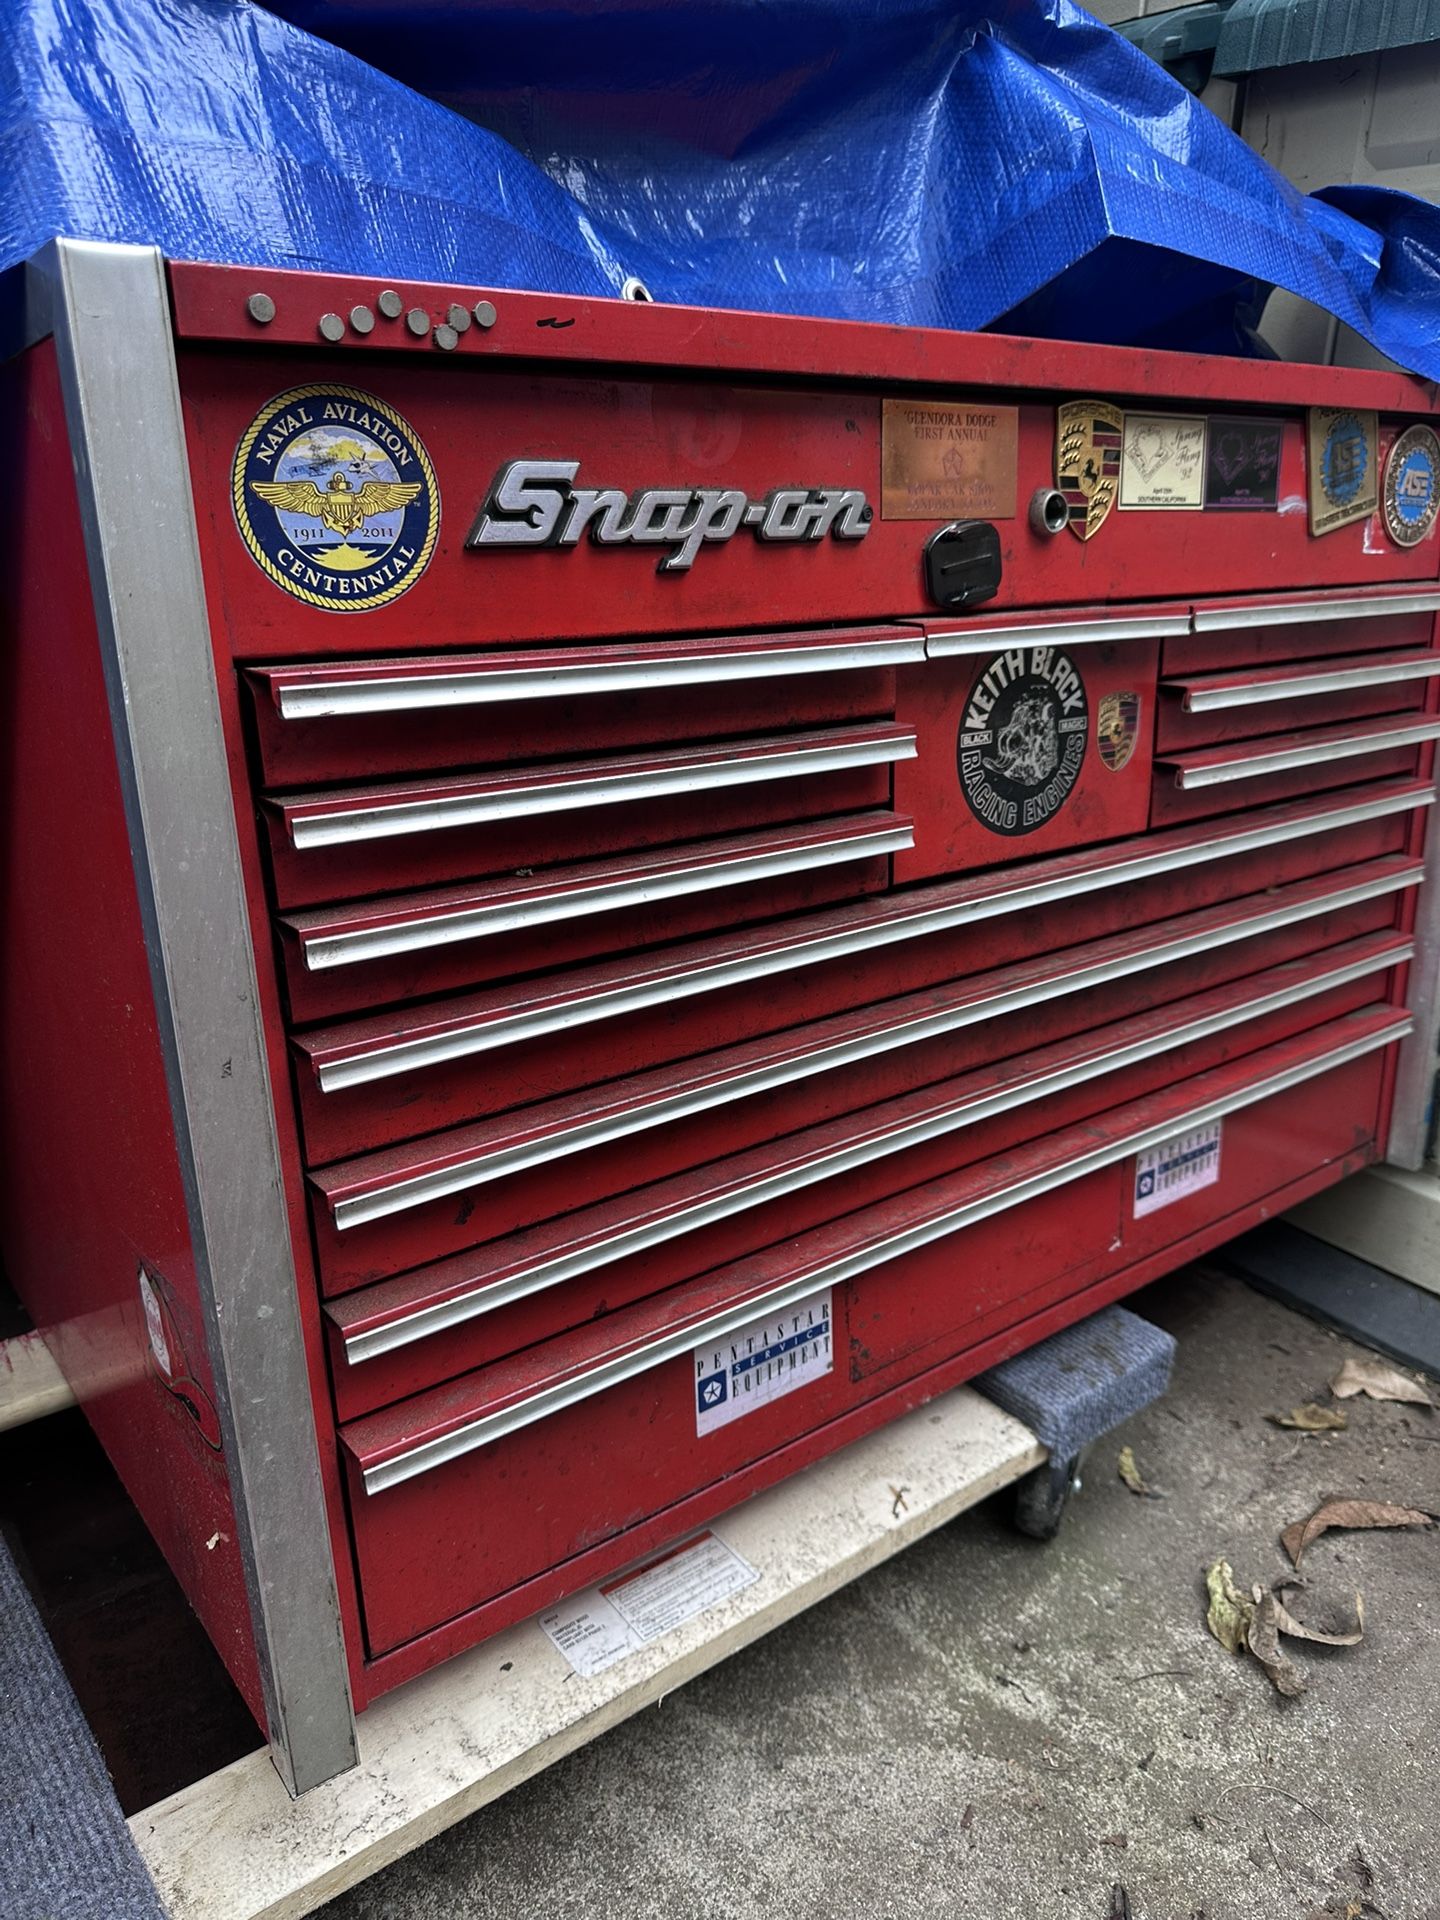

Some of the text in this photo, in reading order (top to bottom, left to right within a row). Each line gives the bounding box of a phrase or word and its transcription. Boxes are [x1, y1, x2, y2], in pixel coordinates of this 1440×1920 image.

[256, 402, 413, 466] NAVAL AVIATION
[293, 529, 325, 542] 1911
[361, 528, 394, 538] 2011
[466, 458, 869, 573] Snap-on
[277, 546, 416, 594] CENTENNIAL
[965, 647, 1084, 730] KEITH BLACK
[963, 733, 990, 746] BLACK
[962, 733, 1084, 829] RACING ENGINES
[697, 1303, 829, 1377] PENTASTAR
[732, 1335, 831, 1399] EQUIPMENT
[734, 1322, 828, 1374] SERVICE
